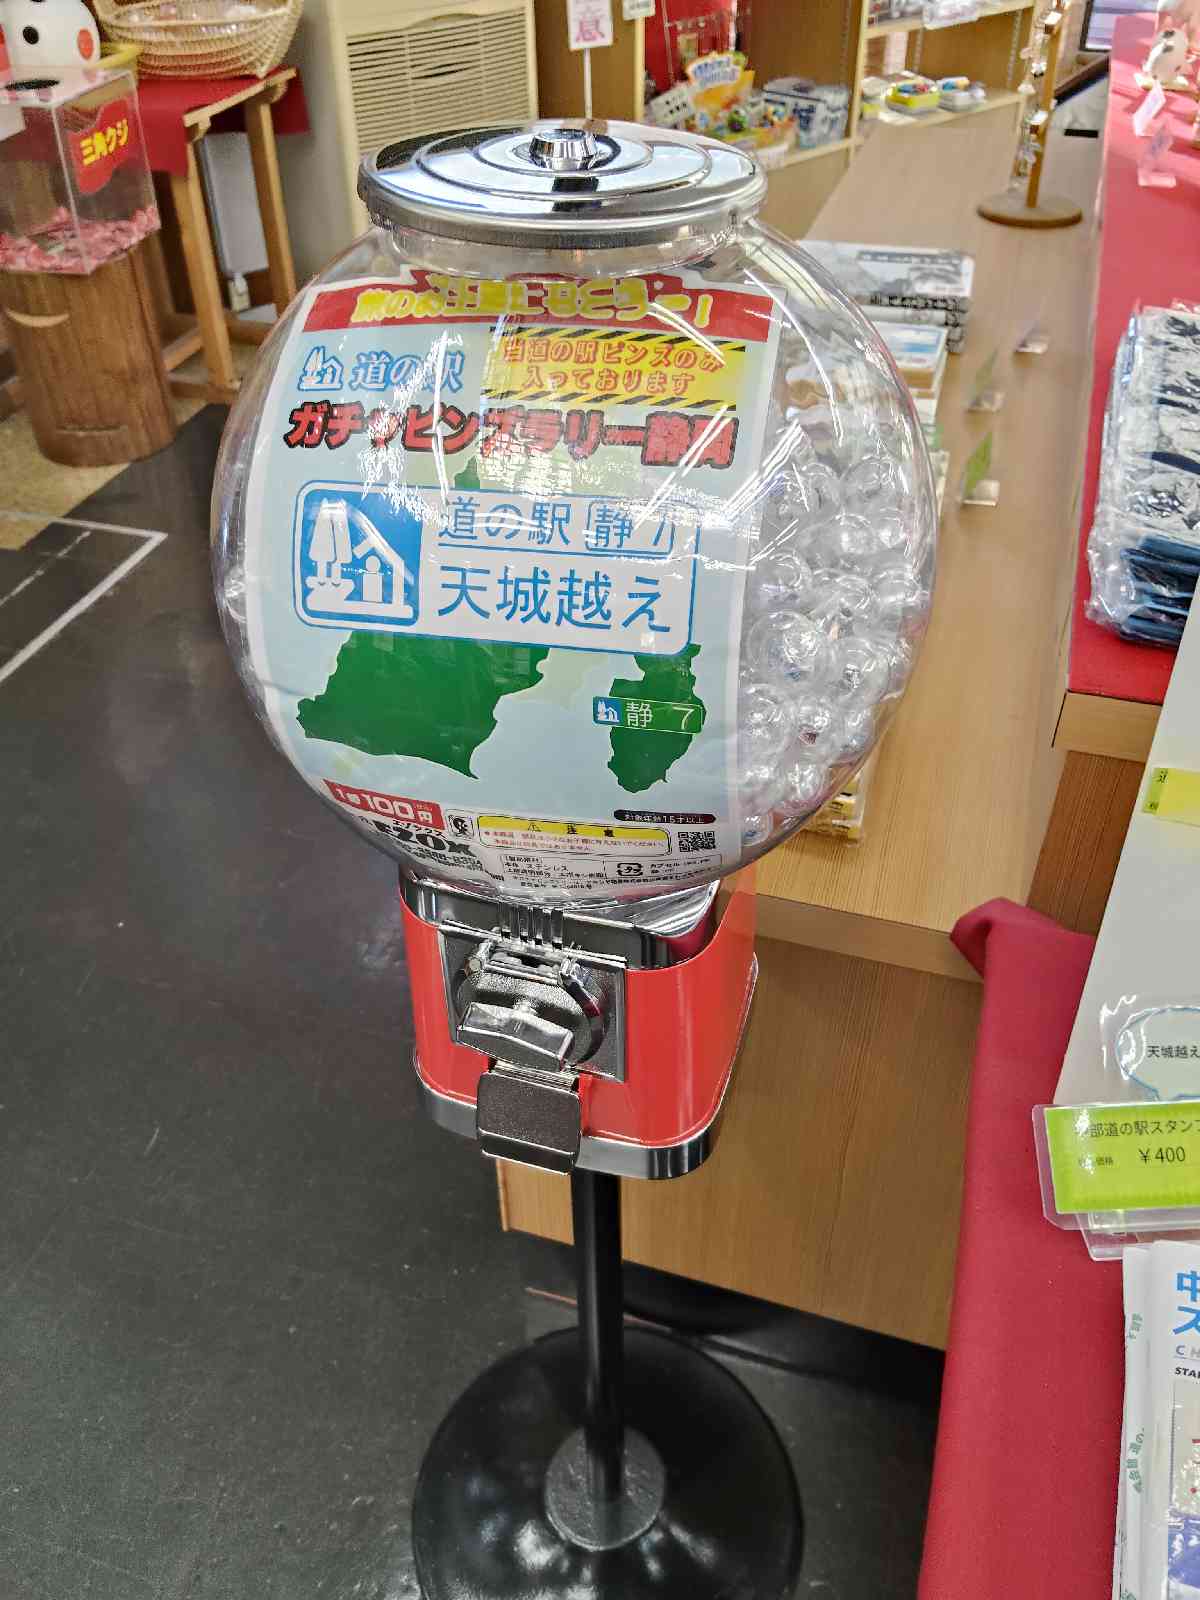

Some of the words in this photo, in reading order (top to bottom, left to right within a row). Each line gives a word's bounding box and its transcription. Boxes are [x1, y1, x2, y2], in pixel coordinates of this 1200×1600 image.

[349, 350, 465, 393] 道の駅
[522, 366, 695, 395] 入っております
[438, 496, 572, 546] 道の駅
[594, 504, 634, 548] 静
[437, 565, 671, 632] 天城越え
[625, 701, 653, 727] 静
[672, 706, 694, 730] 7
[1138, 1146, 1186, 1164] ¥400
